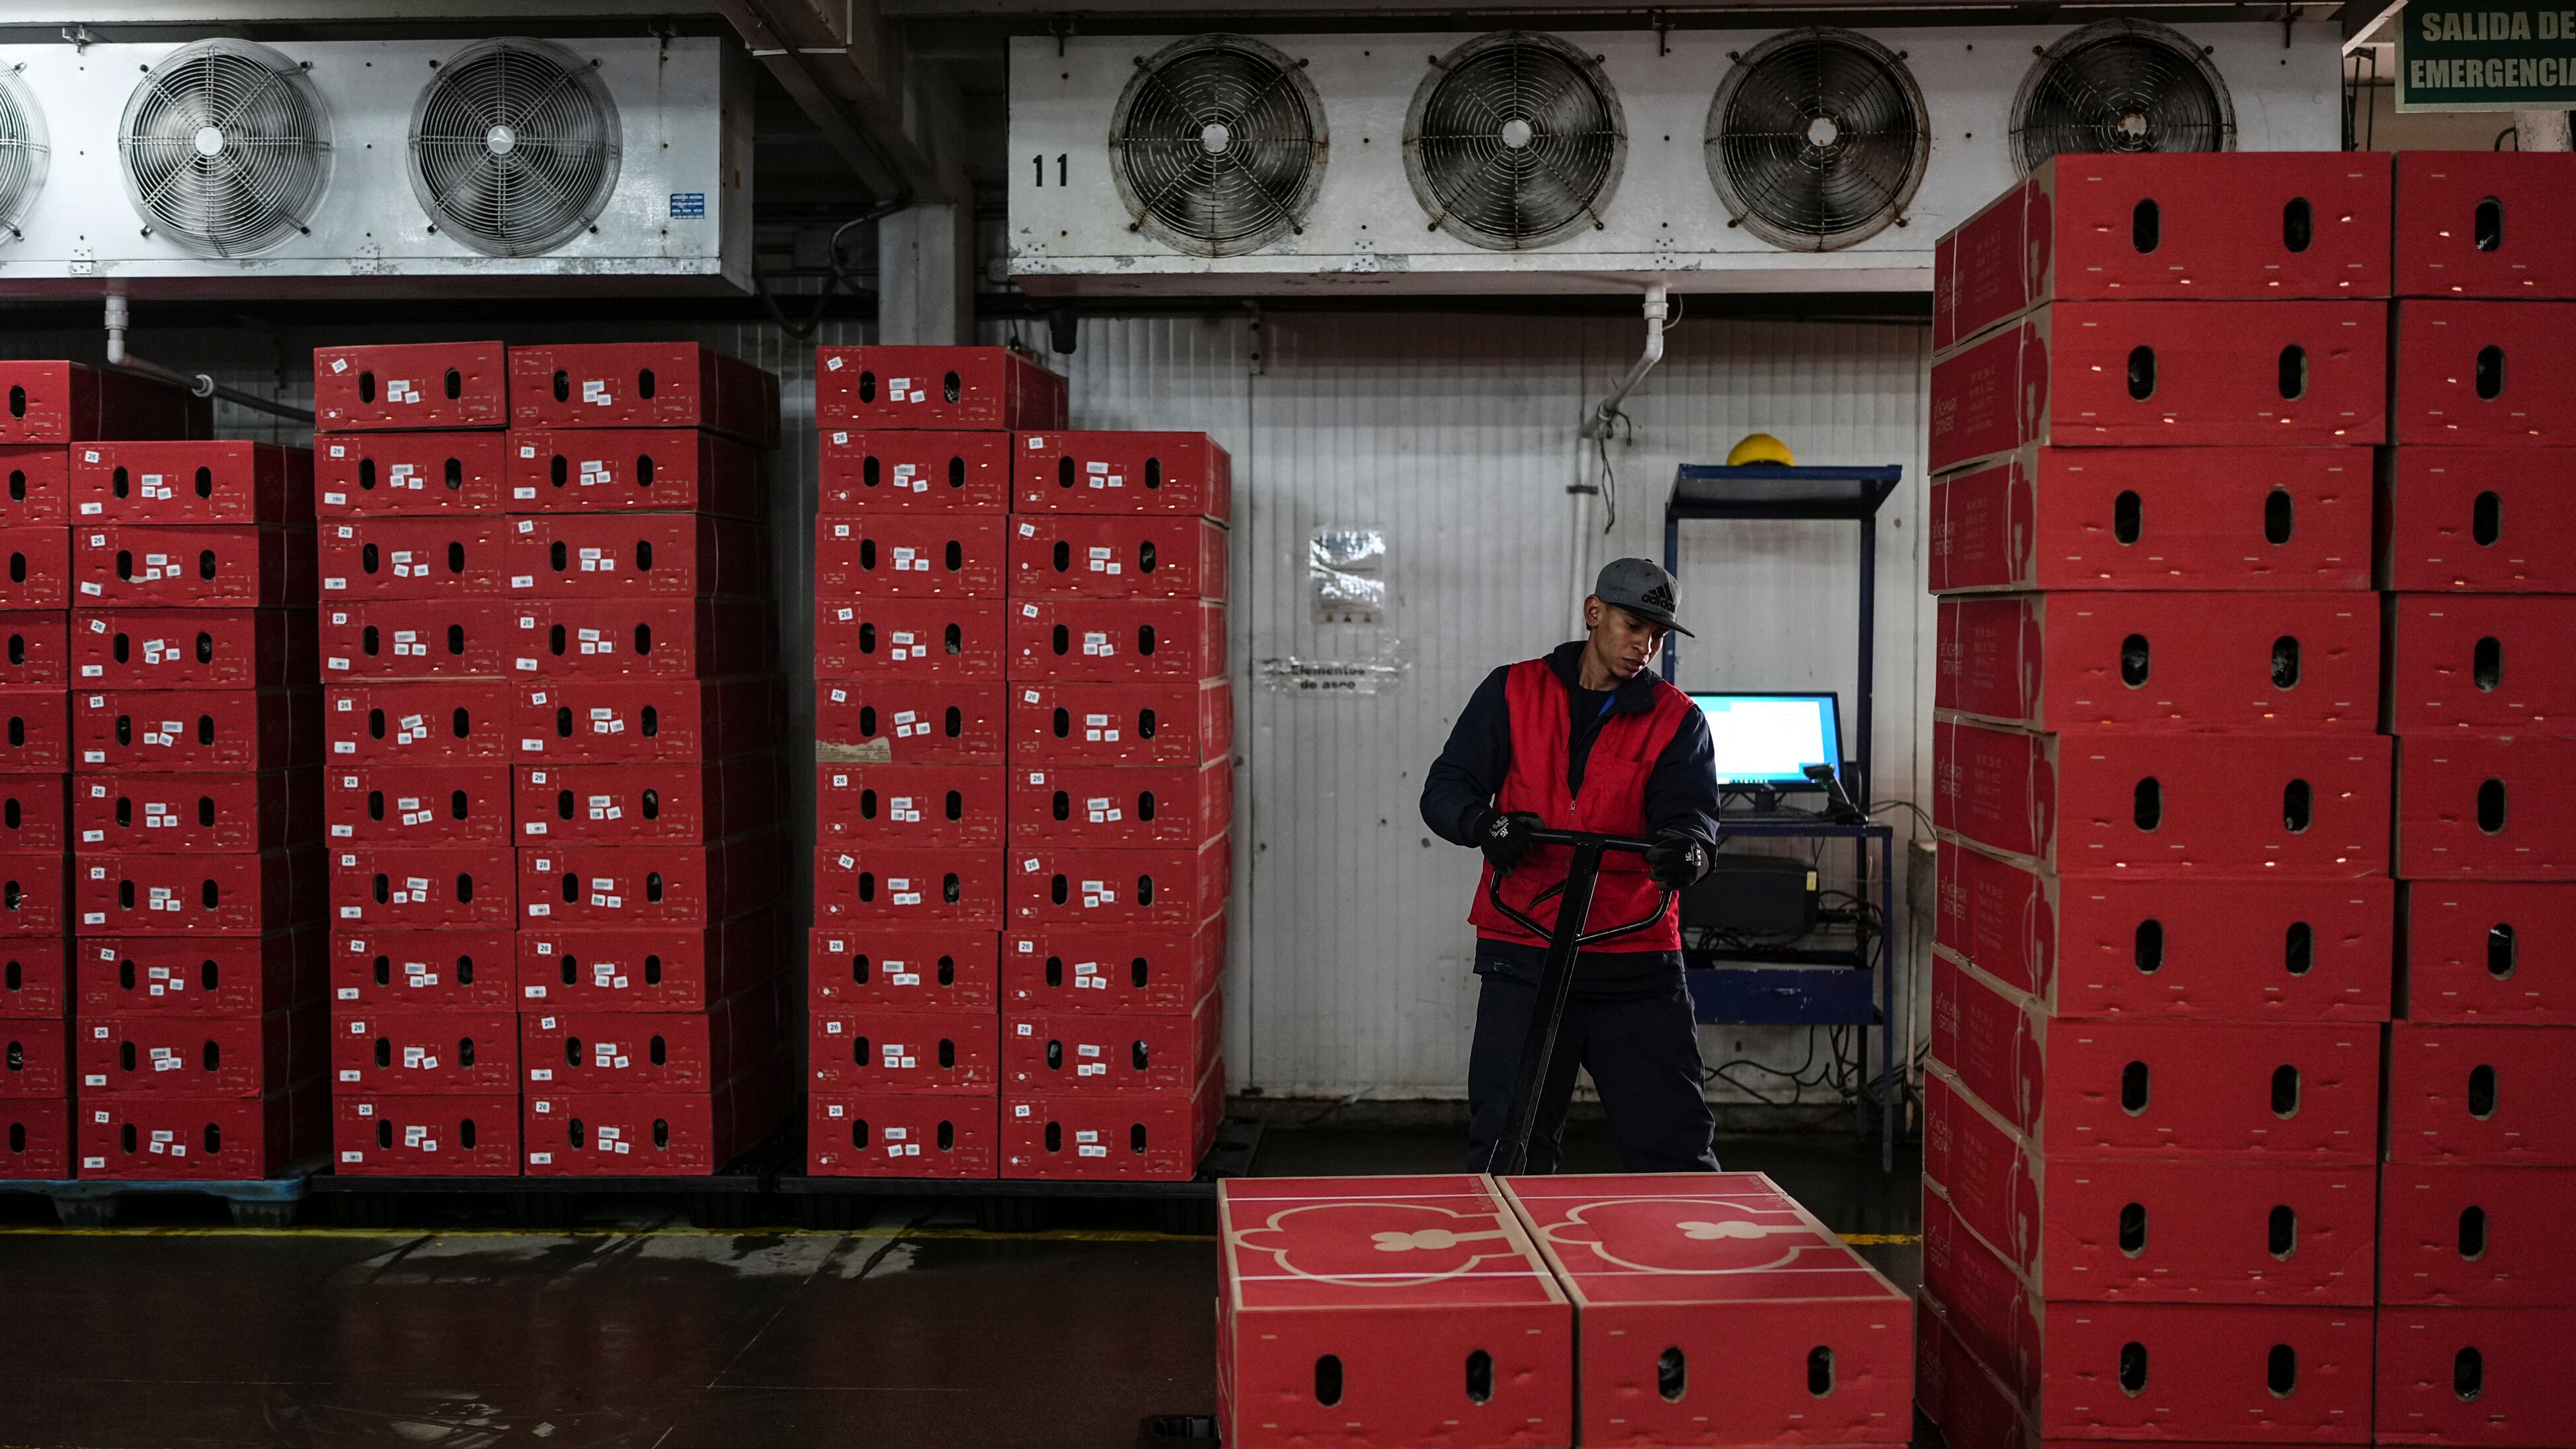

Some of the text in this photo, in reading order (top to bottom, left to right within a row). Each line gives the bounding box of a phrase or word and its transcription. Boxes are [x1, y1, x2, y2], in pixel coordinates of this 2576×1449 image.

[2422, 11, 2576, 41] SALIDA DE
[1033, 153, 1067, 186] 11
[831, 359, 840, 368] 26
[1641, 593, 1676, 614] adidas
[1300, 679, 1318, 690] de
[842, 857, 851, 866] 26
